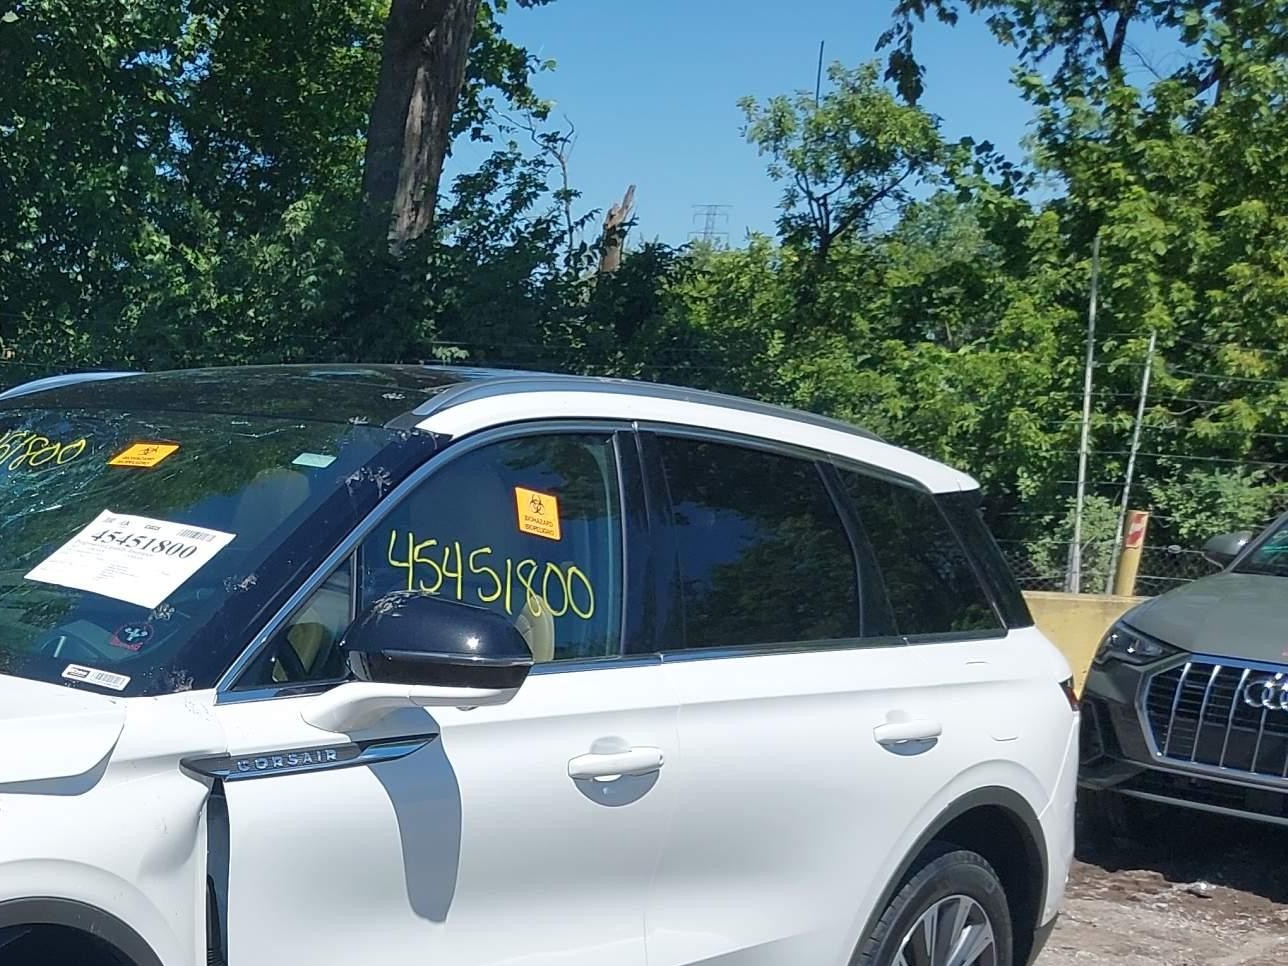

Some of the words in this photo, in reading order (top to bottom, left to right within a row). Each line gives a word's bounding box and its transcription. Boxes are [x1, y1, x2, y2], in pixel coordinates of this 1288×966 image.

[90, 529, 198, 559] 45451800
[387, 529, 595, 619] 45451800
[236, 749, 337, 771] CORSAIR
